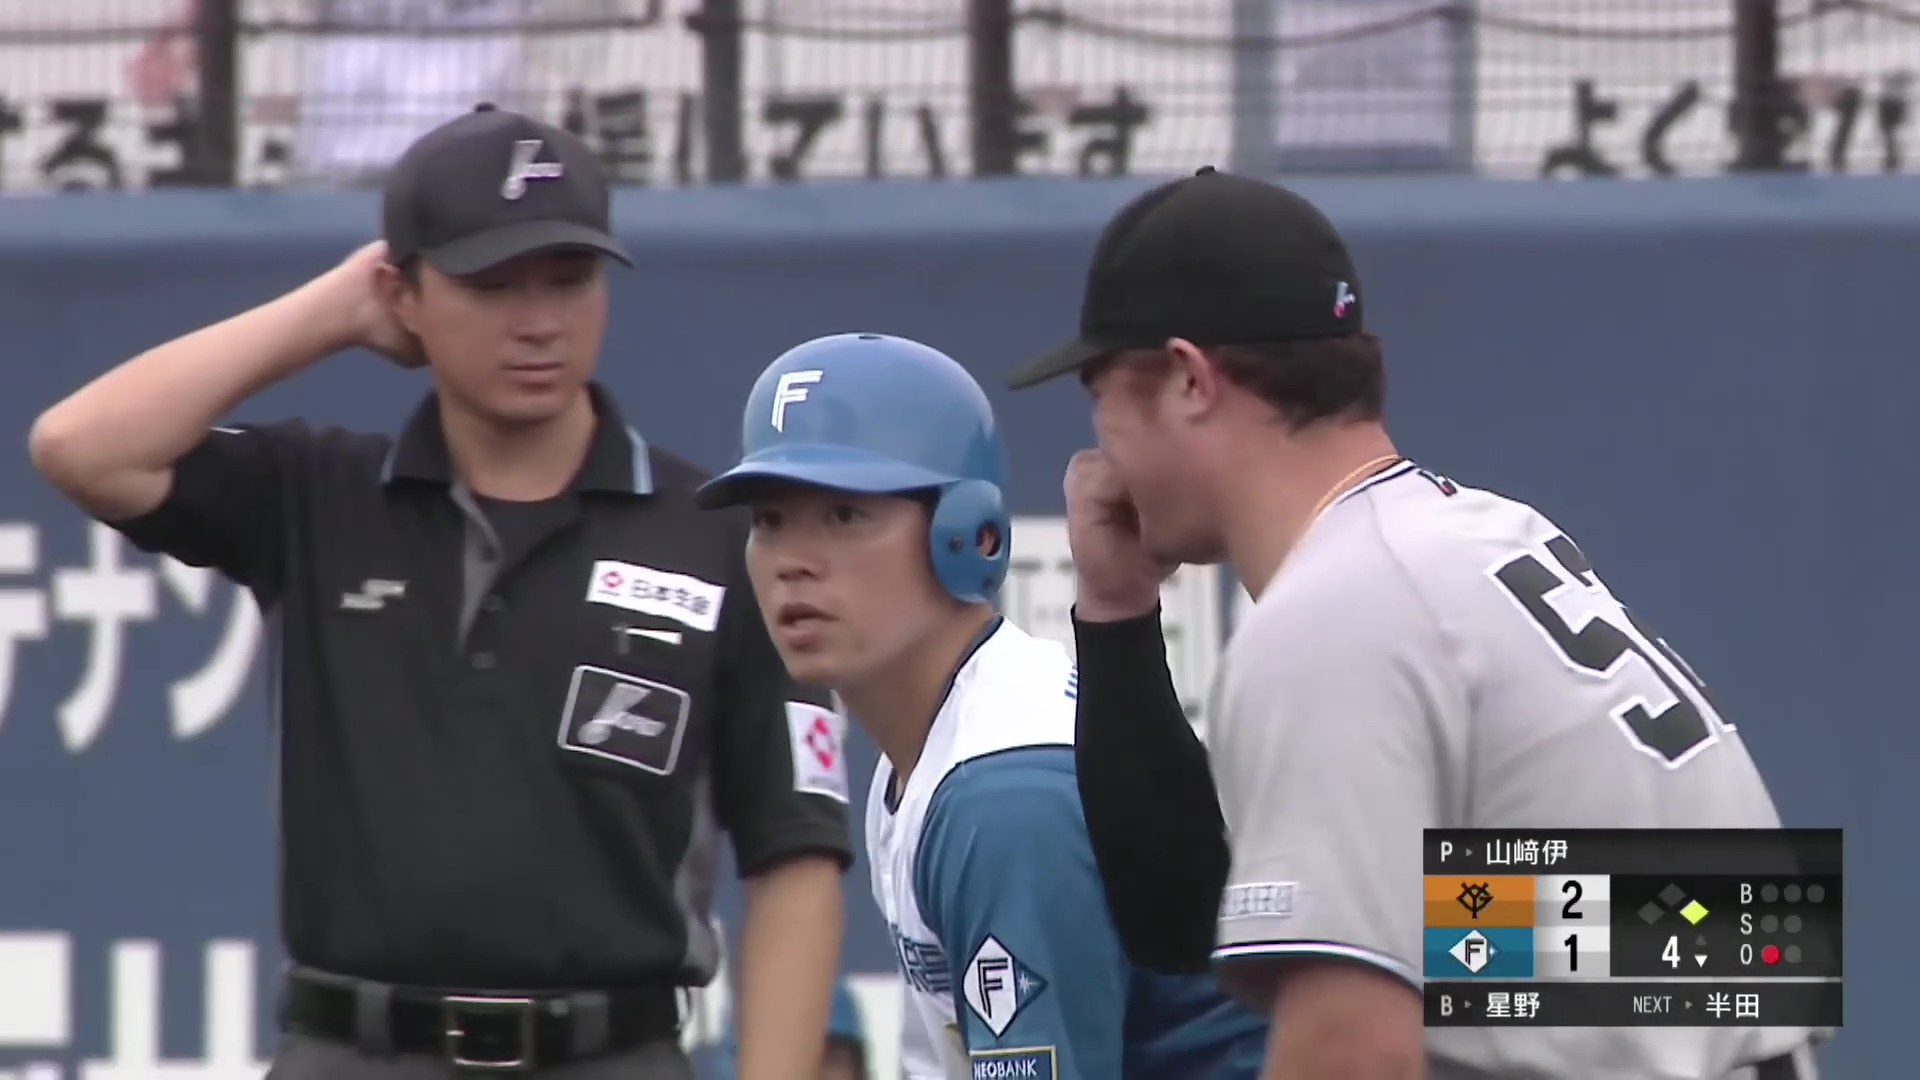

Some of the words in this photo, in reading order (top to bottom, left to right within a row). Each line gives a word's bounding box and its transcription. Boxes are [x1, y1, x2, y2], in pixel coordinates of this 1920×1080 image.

[771, 370, 824, 433] F
[977, 958, 1008, 1019] F
[973, 1058, 1037, 1080] NEOBANK
